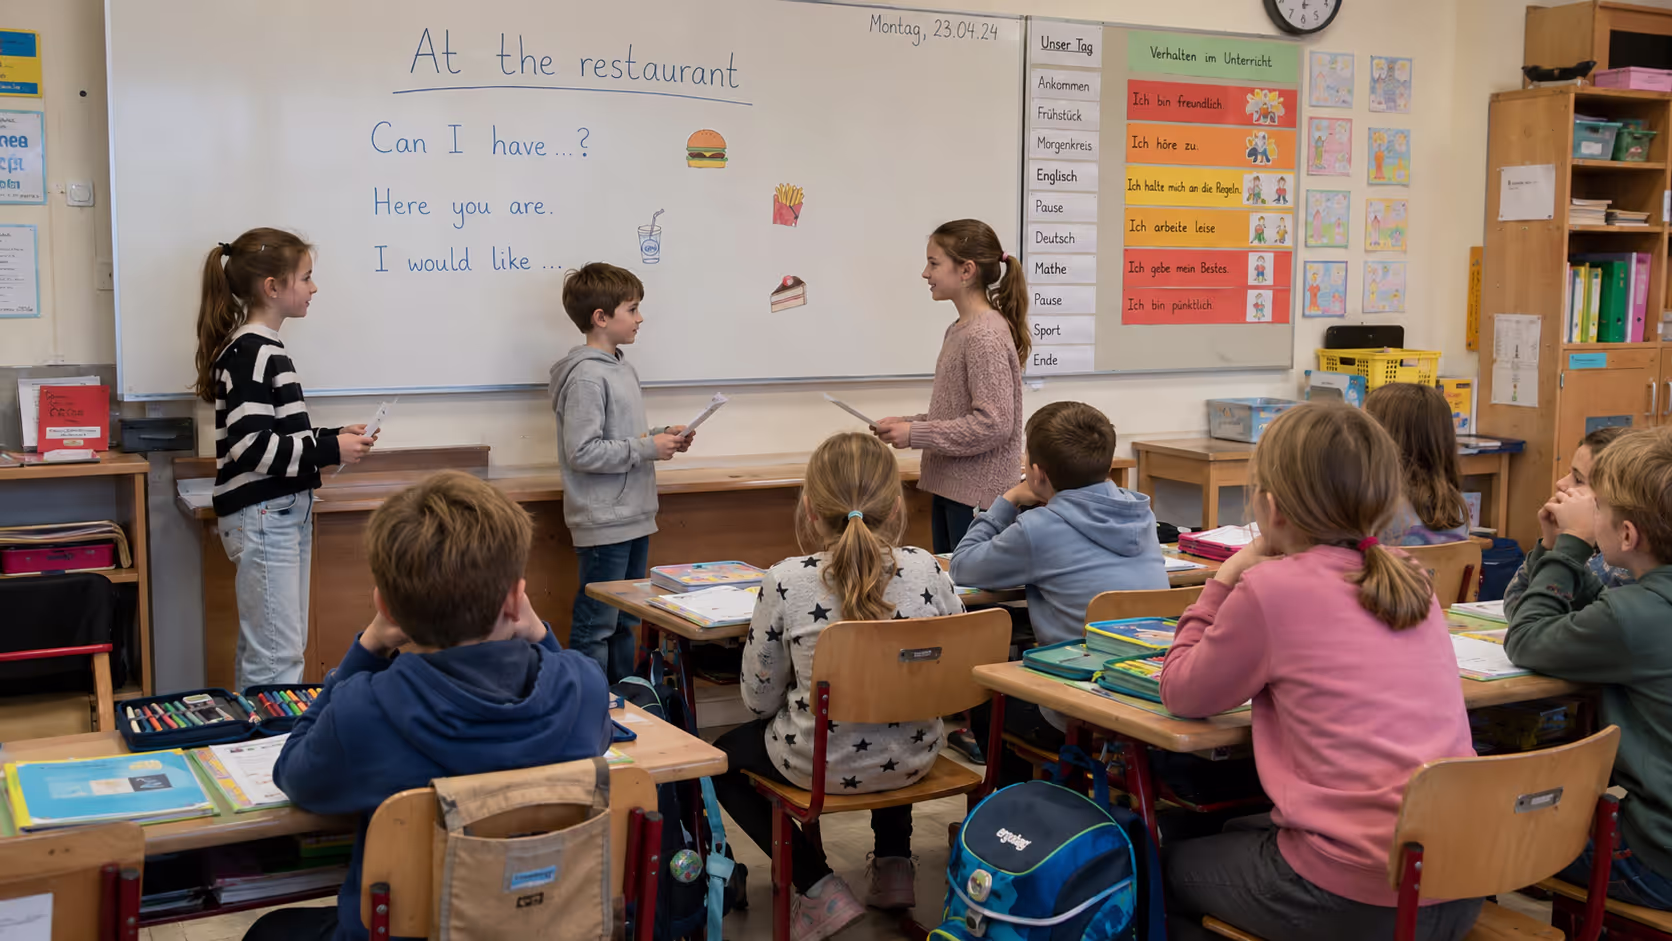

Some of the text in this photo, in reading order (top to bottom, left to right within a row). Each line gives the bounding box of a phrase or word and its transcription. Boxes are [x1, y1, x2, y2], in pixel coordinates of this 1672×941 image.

[1288, 8, 1294, 19] 7
[1300, 14, 1306, 24] 6
[1313, 10, 1319, 21] 5
[869, 13, 998, 47] Montag, 23.04.24
[1040, 35, 1094, 56] Unser Tag
[410, 27, 740, 89] At the restaurant
[1149, 45, 1273, 68] Verhalten im Unterricht
[1037, 75, 1090, 92] Ankommen
[1132, 91, 1150, 106] Ich
[1157, 93, 1171, 107] bin
[1037, 105, 1083, 122] Frühstück
[371, 120, 427, 154] Can
[447, 124, 464, 154] I
[1037, 135, 1093, 155] Morgenkreis
[1131, 135, 1149, 149] Ich
[1156, 136, 1178, 151] höre
[1036, 167, 1078, 186] Englisch
[1127, 177, 1142, 192] Ich
[1144, 179, 1165, 193] halte
[1167, 181, 1186, 193] mich
[1188, 185, 1199, 193] an
[1201, 181, 1213, 194] die
[374, 186, 553, 230] Here you are.
[1035, 199, 1064, 214] Pause
[1128, 218, 1216, 234] Ich arbeite leise
[1035, 230, 1076, 245] Deutsch
[374, 244, 389, 273] I
[407, 246, 473, 272] would
[492, 245, 531, 271] like
[1034, 261, 1067, 275] Mathe
[1128, 260, 1145, 274] Ich
[1150, 261, 1171, 279] gebe
[1175, 263, 1196, 274] mein
[1034, 292, 1063, 306] Pause
[1127, 297, 1145, 311] Ich
[1151, 298, 1166, 311] bin
[1033, 323, 1062, 340] Sport
[1033, 353, 1058, 367] Ende
